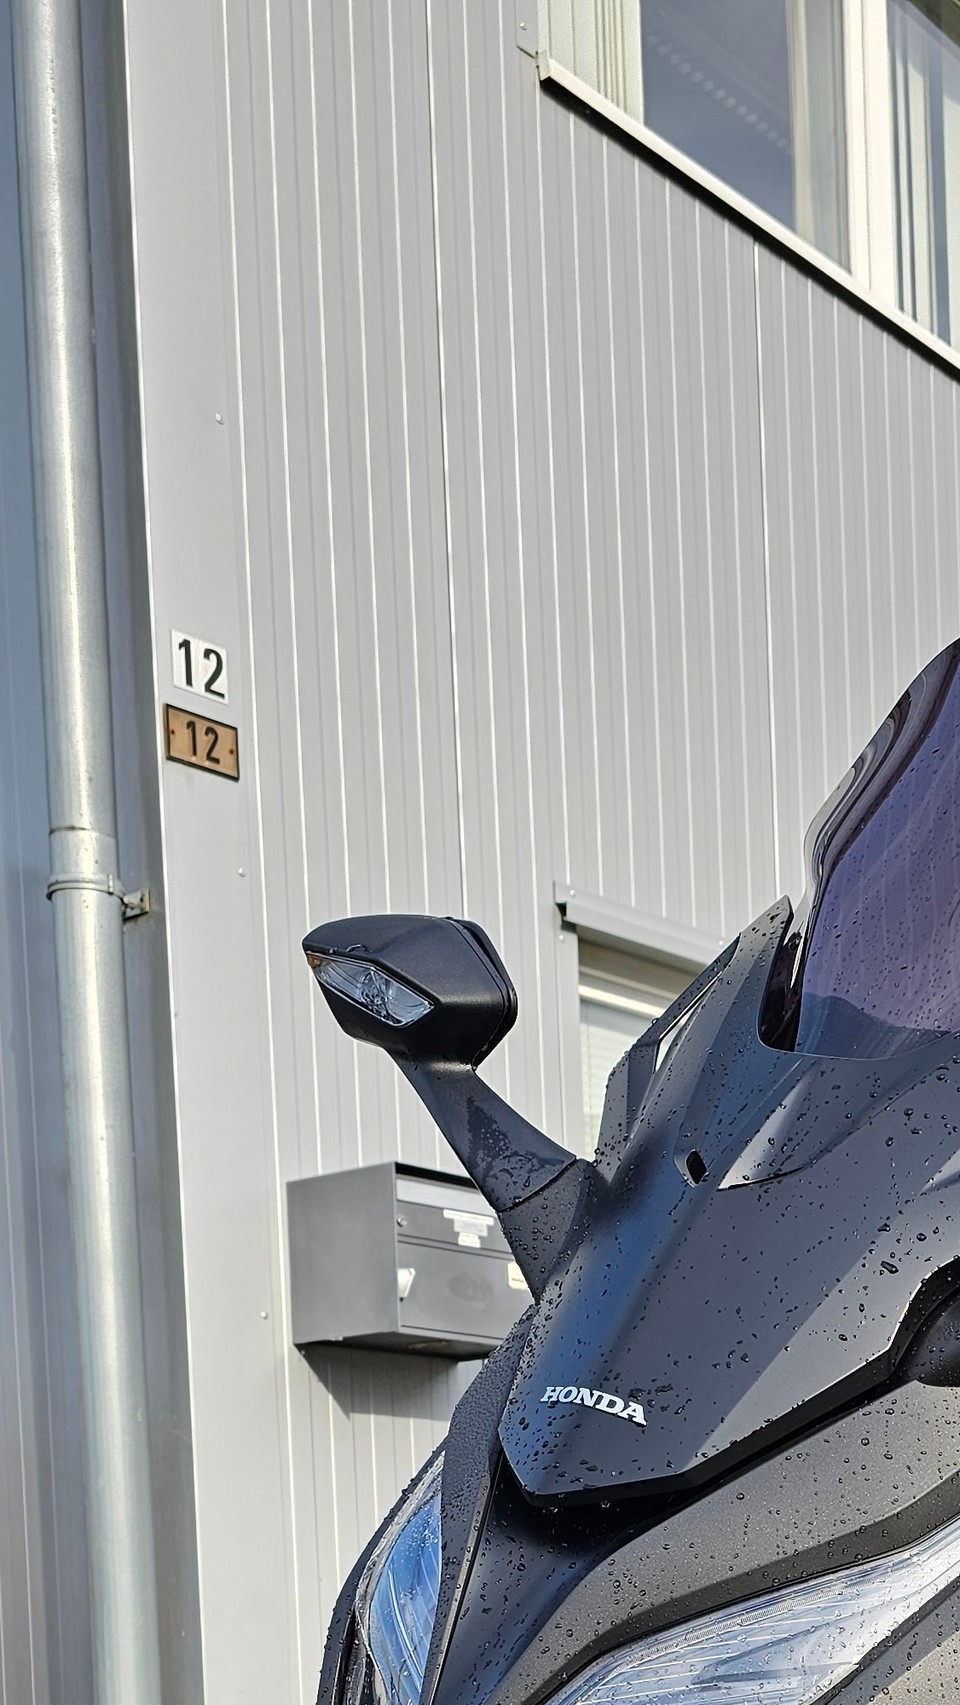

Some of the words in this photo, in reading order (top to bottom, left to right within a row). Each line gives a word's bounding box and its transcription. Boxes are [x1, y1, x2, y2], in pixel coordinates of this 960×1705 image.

[178, 638, 225, 699] 12
[186, 720, 221, 765] 12
[540, 1385, 648, 1427] HONDA
